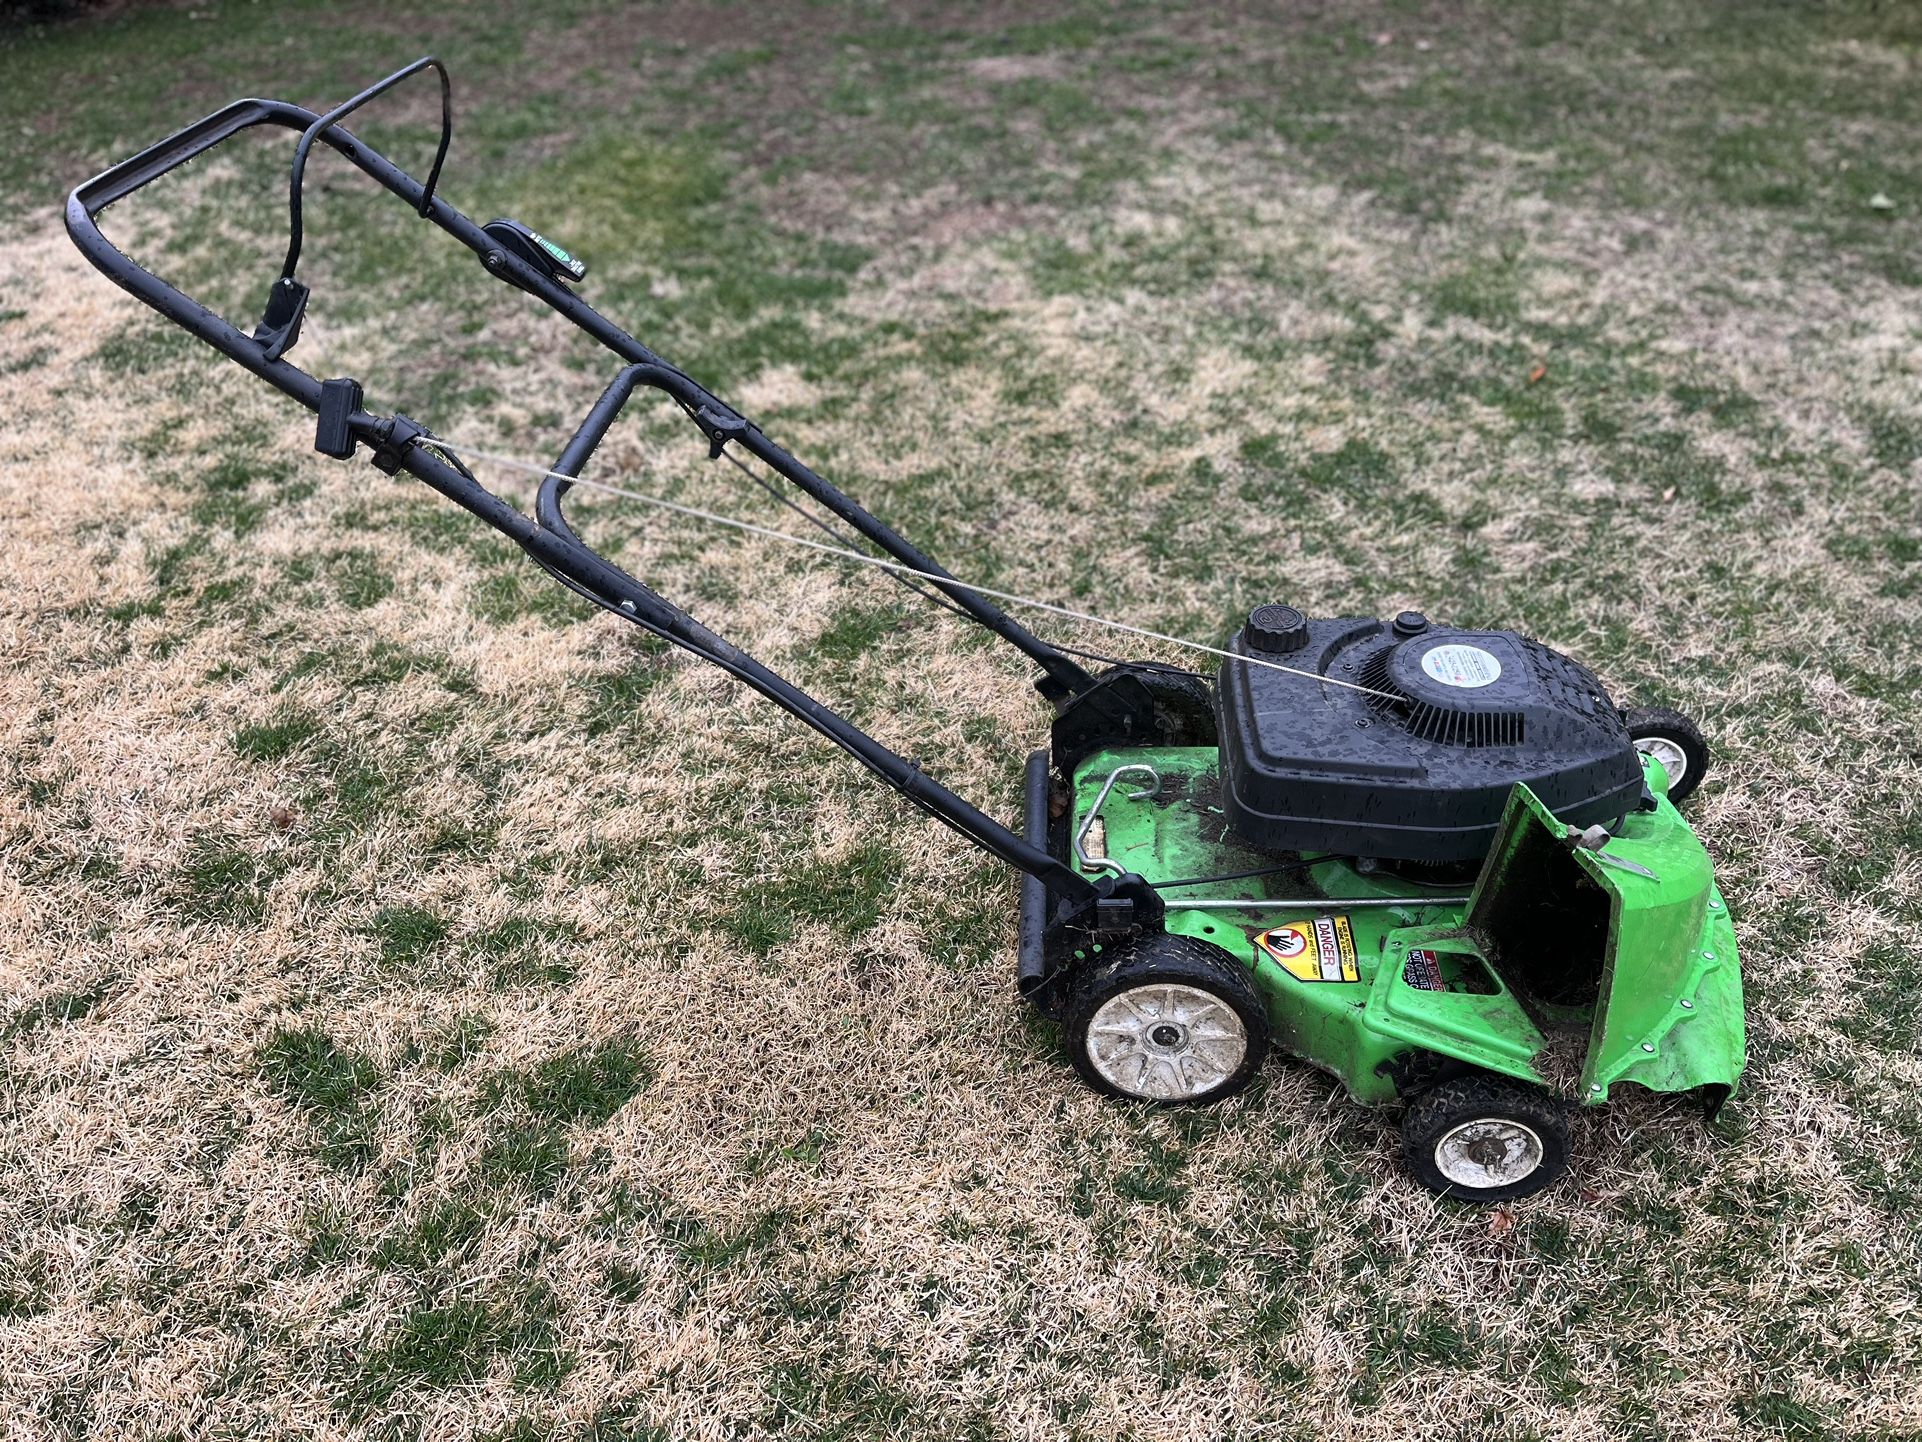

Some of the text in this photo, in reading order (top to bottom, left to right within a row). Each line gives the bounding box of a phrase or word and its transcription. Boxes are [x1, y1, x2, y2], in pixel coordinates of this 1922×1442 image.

[1318, 924, 1335, 965] DANGER
[1411, 950, 1422, 963] NOT
[1429, 966, 1443, 991] DANGER
